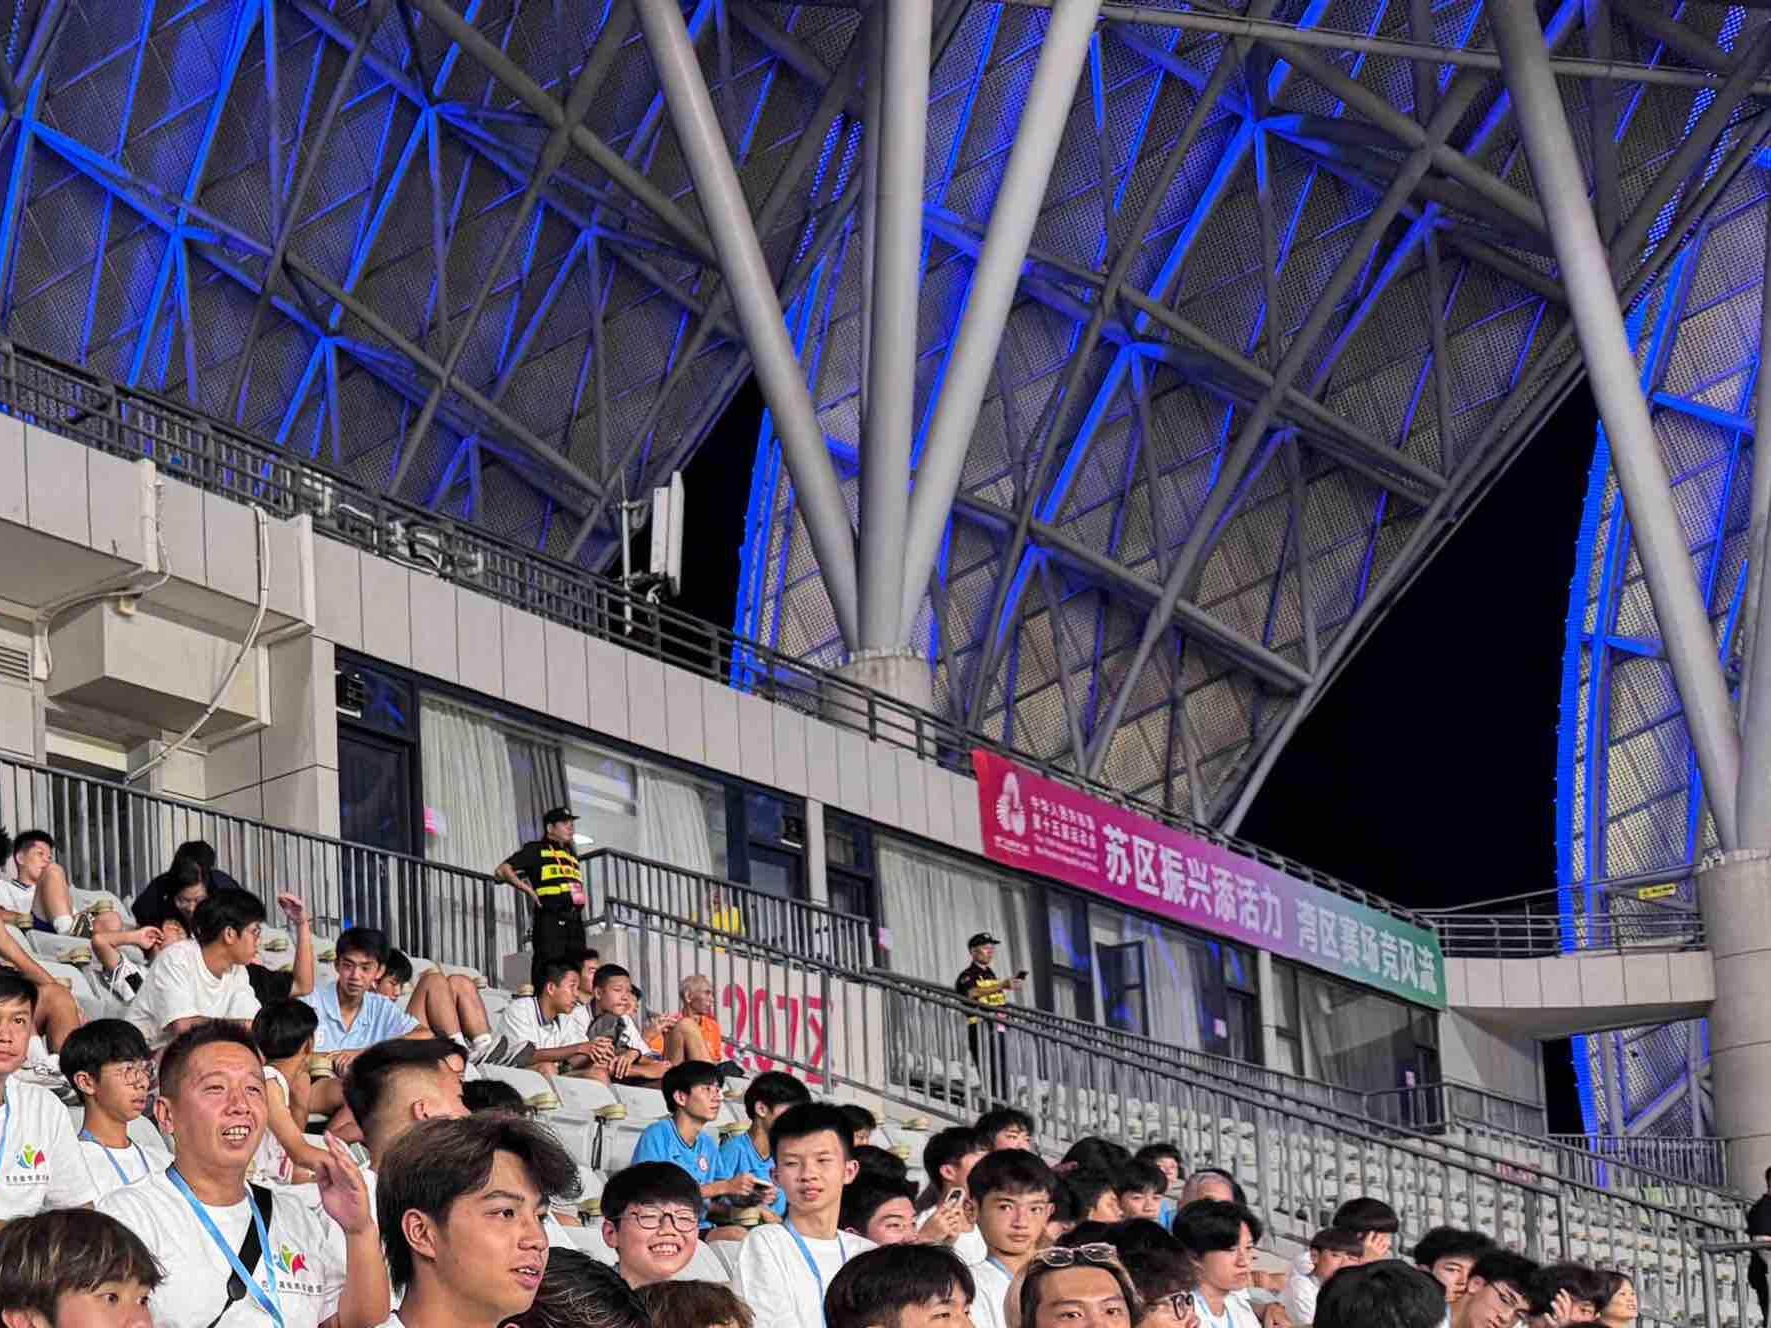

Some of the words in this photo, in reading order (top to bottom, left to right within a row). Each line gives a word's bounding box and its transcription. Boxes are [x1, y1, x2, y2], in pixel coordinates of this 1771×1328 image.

[1102, 823, 1283, 939] 苏区振兴添活力
